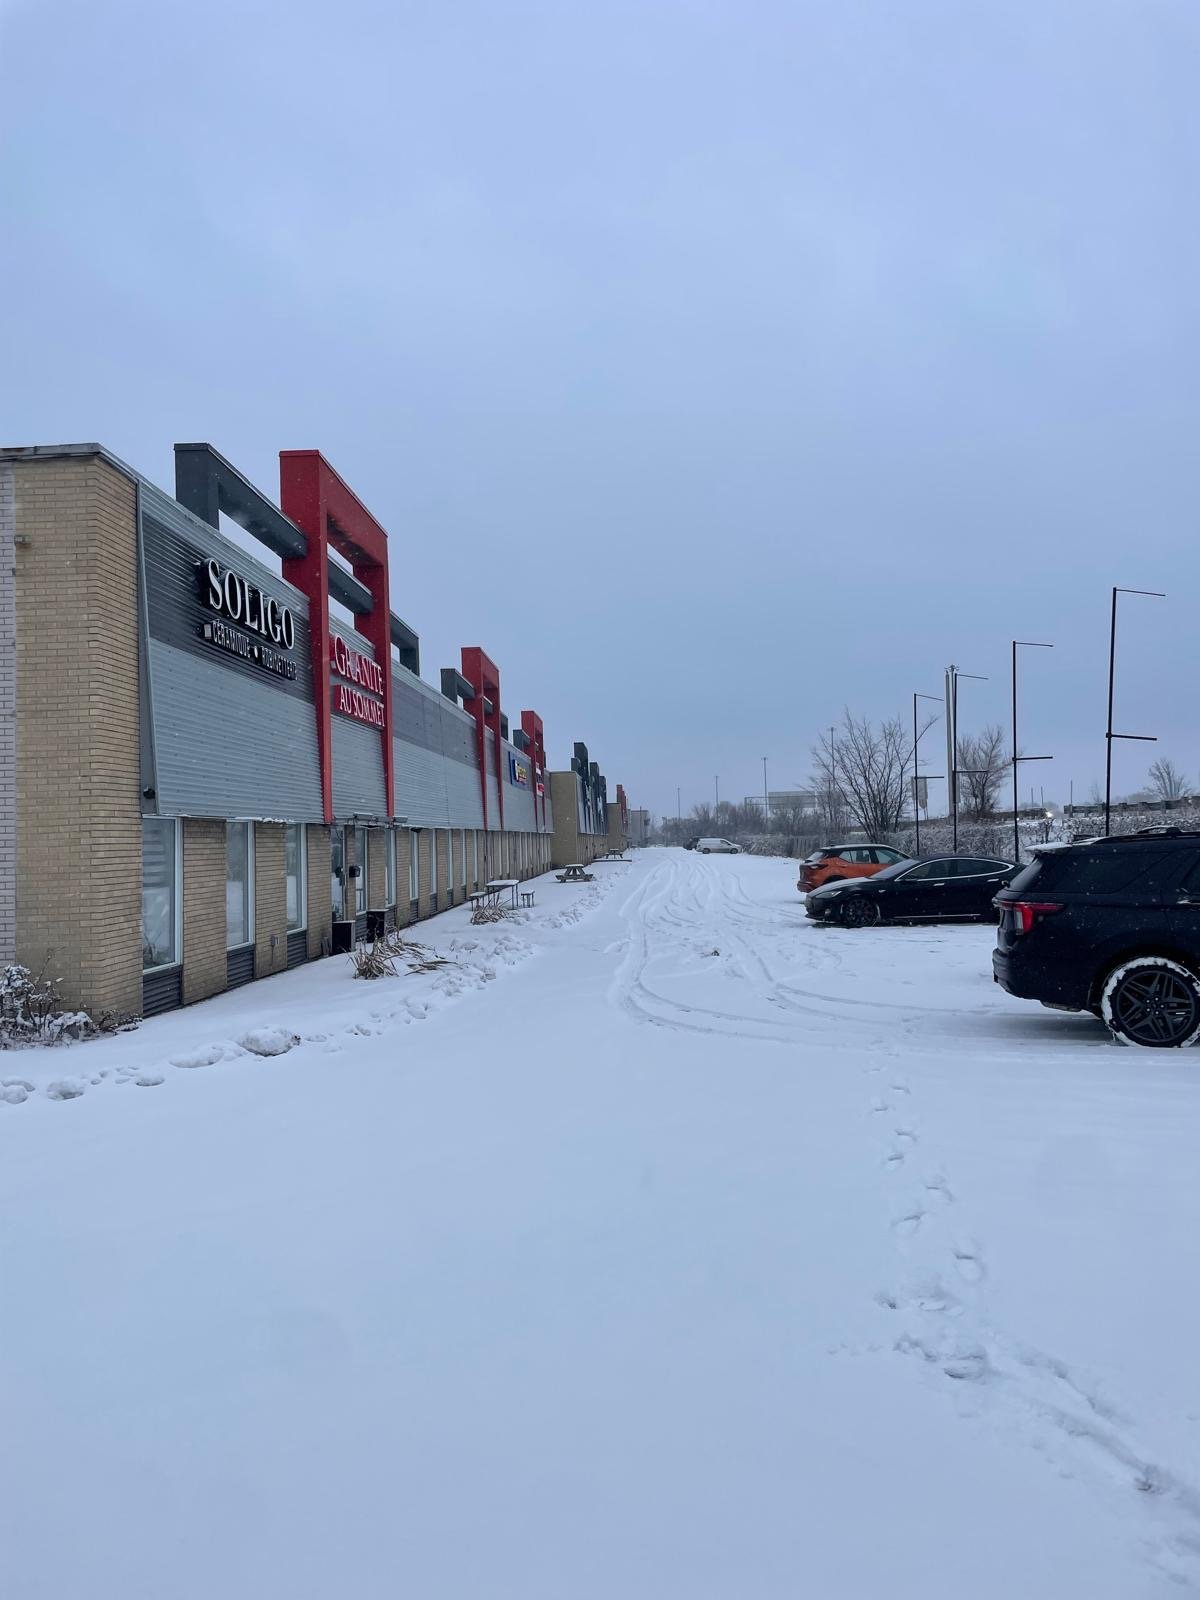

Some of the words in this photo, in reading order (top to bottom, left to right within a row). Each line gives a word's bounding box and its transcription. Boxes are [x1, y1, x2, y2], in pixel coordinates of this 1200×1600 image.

[208, 559, 295, 650] SOLIGO
[212, 619, 251, 659] CÉRAMIQUE
[334, 635, 384, 696] GRANITE
[339, 685, 352, 714] AU
[352, 689, 385, 727] SOMMET
